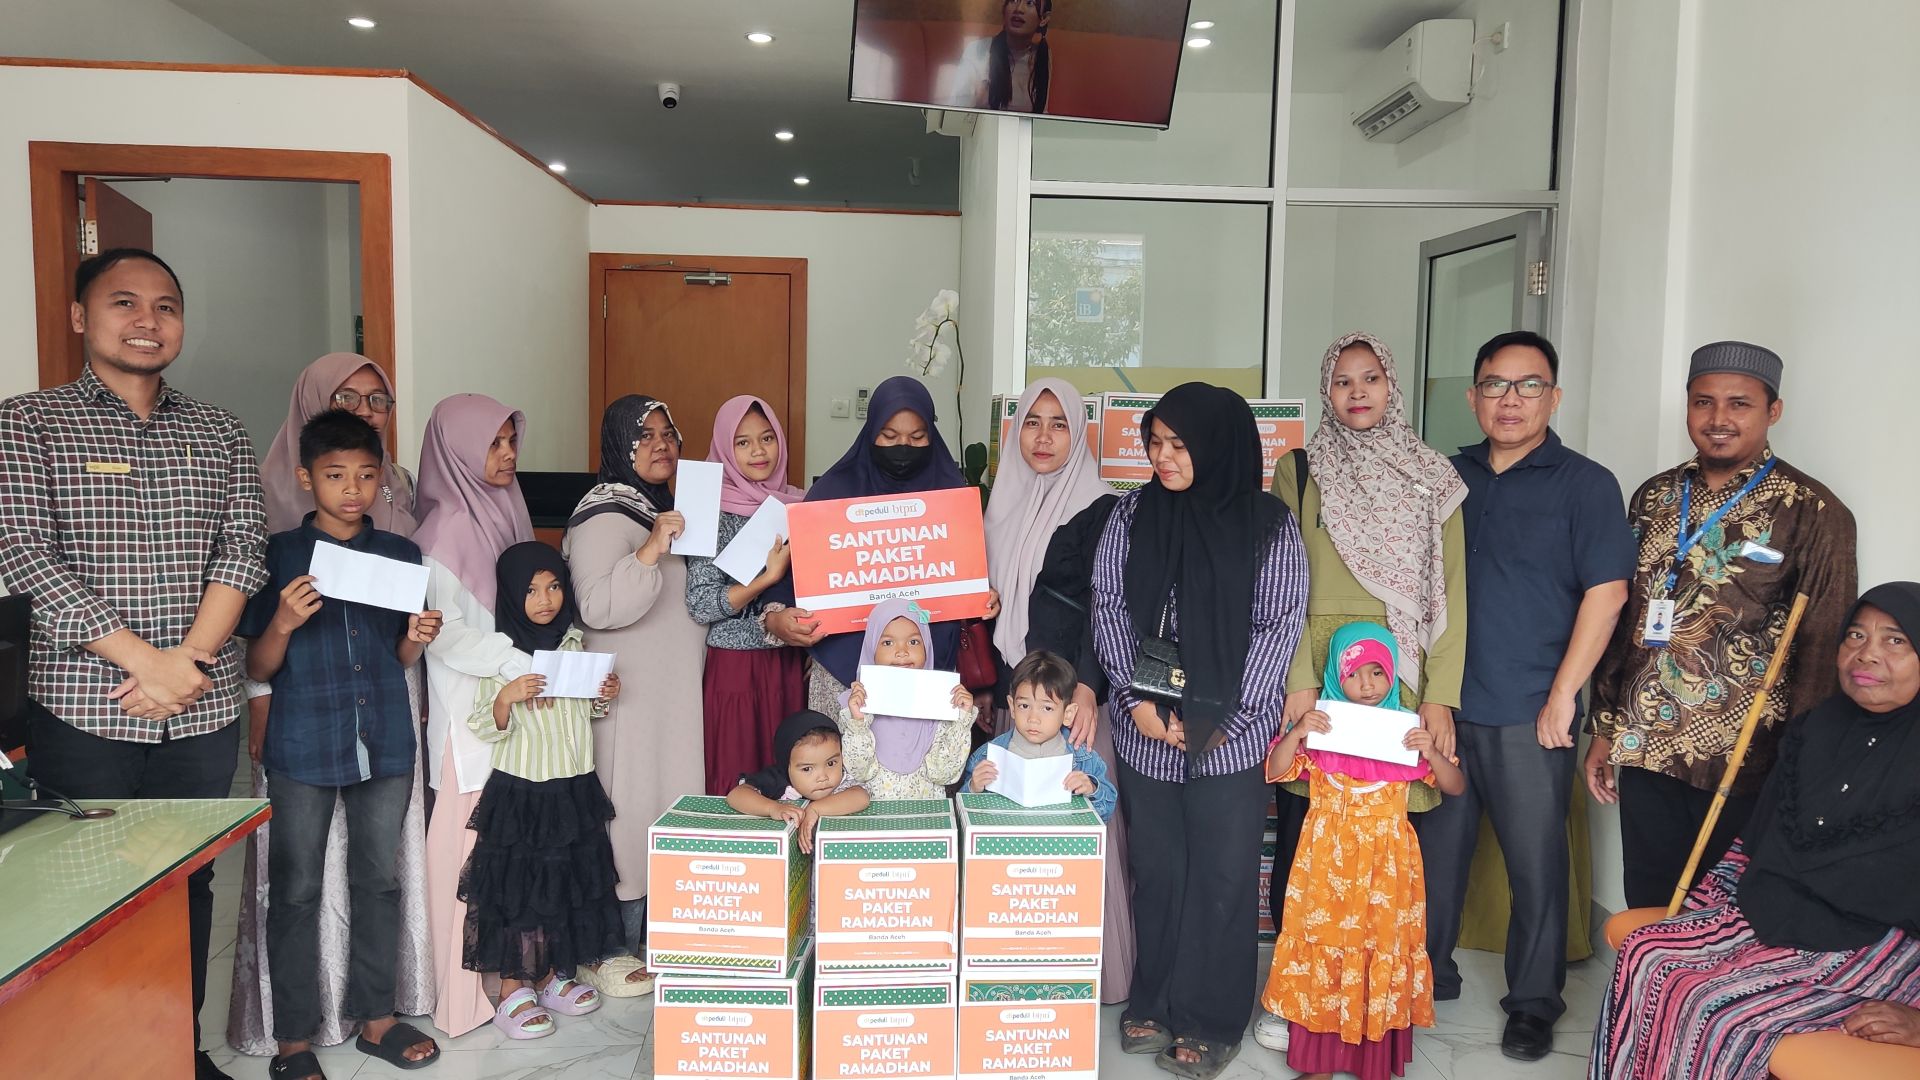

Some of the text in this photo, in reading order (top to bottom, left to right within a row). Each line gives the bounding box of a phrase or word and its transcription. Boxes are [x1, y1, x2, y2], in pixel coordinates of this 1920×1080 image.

[828, 523, 948, 550] SANTUNAN
[856, 545, 926, 566] PAKET
[828, 561, 956, 589] RAMADHAN
[869, 589, 920, 601] Banda Aceh
[675, 879, 760, 895] SANTUNAN
[844, 887, 931, 900] SANTUNAN
[991, 883, 1076, 897] SANTUNAN
[692, 894, 742, 908] PAKET
[862, 901, 912, 914] PAKET
[1009, 897, 1059, 910] PAKET
[672, 907, 763, 923] RAMADHAN
[841, 915, 933, 929] RAMADHAN
[988, 911, 1079, 924] RAMADHAN
[681, 1031, 767, 1046] SANTUNAN
[842, 1032, 928, 1047] SANTUNAN
[985, 1028, 1070, 1042] SANTUNAN
[698, 1046, 749, 1059] PAKET
[860, 1047, 910, 1060] PAKET
[1003, 1042, 1053, 1055] PAKET
[677, 1060, 770, 1074] RAMADHAN
[839, 1061, 931, 1075] RAMADHAN
[982, 1056, 1073, 1070] RAMADHAN
